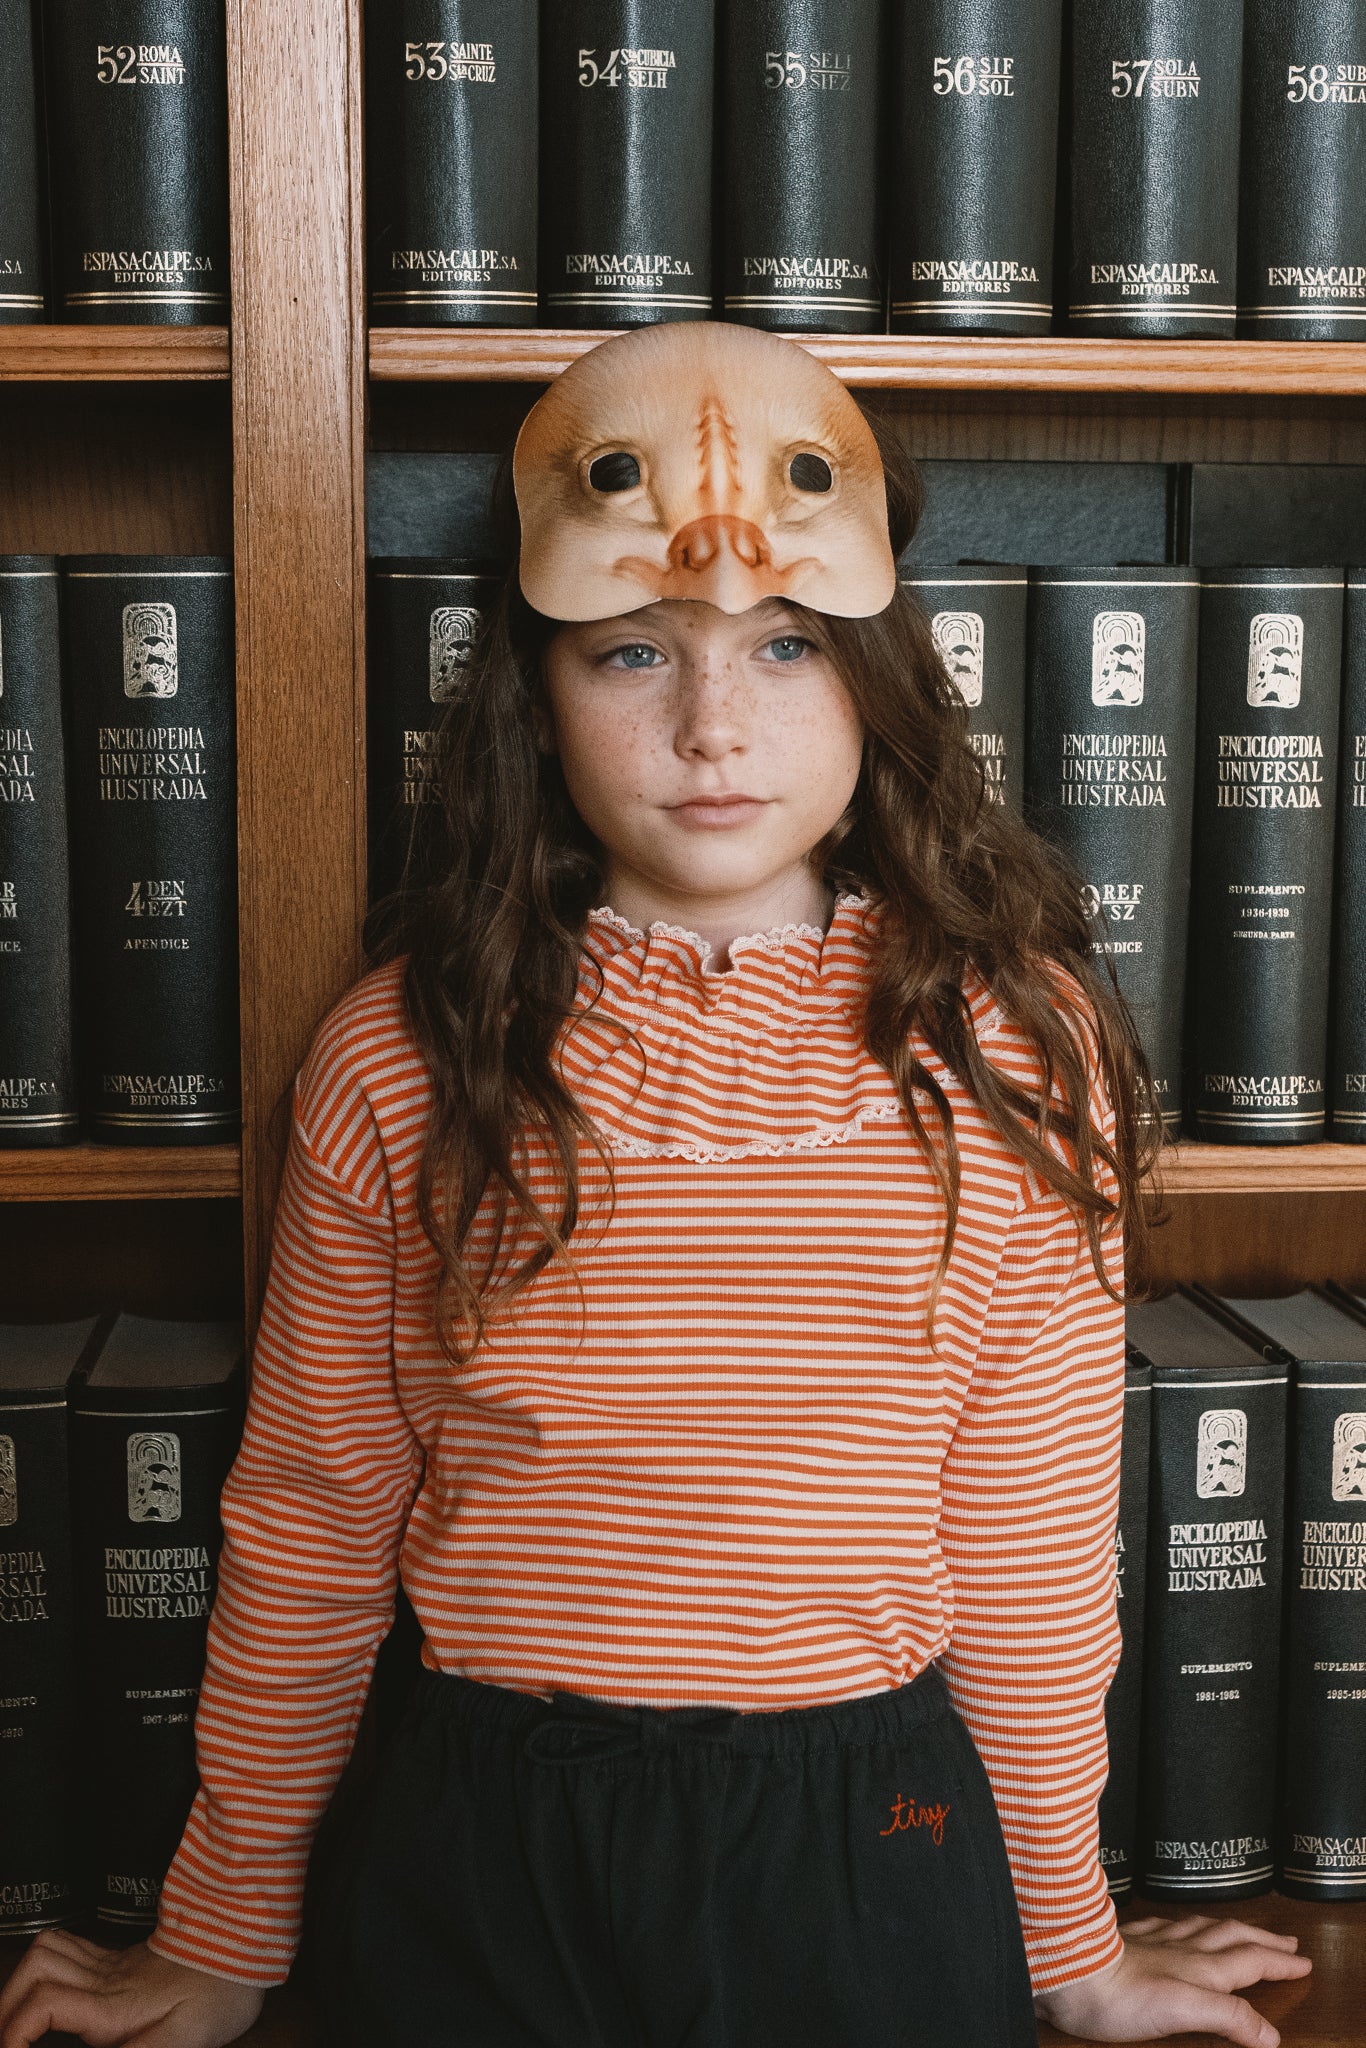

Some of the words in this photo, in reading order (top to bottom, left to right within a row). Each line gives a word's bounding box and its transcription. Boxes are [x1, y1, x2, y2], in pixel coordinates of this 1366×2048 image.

[139, 45, 182, 63] ROMA
[450, 41, 494, 61] SAINTE
[97, 45, 137, 84] 52
[405, 42, 447, 81] 53
[578, 48, 622, 88] 54
[765, 51, 806, 89] 55
[980, 57, 1014, 75] SIF
[1154, 59, 1197, 76] SOLA
[140, 66, 186, 85] SAINT
[628, 70, 667, 89] SELH
[810, 73, 851, 92] SIEZ
[933, 56, 975, 95] 56
[1111, 59, 1153, 98] 57
[1287, 65, 1329, 103] 58
[978, 79, 1014, 96] SOL
[1150, 80, 1199, 98] SUBN
[1329, 85, 1366, 103] TALA
[114, 271, 184, 284] EDITORES
[422, 270, 491, 282] EDITORES
[595, 275, 663, 287] EDITORES
[774, 277, 842, 290] EDITORES
[942, 281, 1011, 293] EDITORES
[1121, 284, 1190, 296] EDITORES
[1299, 286, 1366, 298] EDITORES
[98, 727, 205, 750] ENCICLOPEDIA
[1062, 734, 1167, 757] ENCICLOPEDIA
[1218, 735, 1323, 758] ENCICLOPEDIA
[100, 752, 206, 775] UNIVERSAL
[1063, 759, 1167, 782] UNIVERSAL
[1218, 761, 1323, 783] UNIVERSAL
[100, 778, 207, 801] ILUSTRADA
[1061, 784, 1166, 807] ILUSTRADA
[1217, 785, 1322, 809] ILUSTRADA
[147, 880, 185, 897] DEN
[1103, 884, 1144, 900] REF
[1228, 885, 1306, 895] SUPLEMENTO
[125, 881, 144, 917] 4
[148, 900, 188, 917] EZT
[1110, 904, 1135, 921] SZ
[1240, 907, 1290, 918] 1936-1939
[1233, 930, 1268, 939] SEGUNDA
[1270, 931, 1296, 939] PARTE
[123, 938, 190, 951] APENDICE
[130, 1094, 197, 1107] EDITORES
[1232, 1095, 1299, 1107] EDITORES
[1168, 1519, 1268, 1545] ENCICLOPEDIA
[104, 1547, 211, 1571] ENCICLOPEDIA
[1168, 1542, 1267, 1568] UNIVERSAL
[106, 1569, 211, 1595] UNIVERSAL
[1168, 1566, 1266, 1592] ILUSTRADA
[106, 1595, 211, 1619] ILUSTRADA
[1180, 1661, 1253, 1674] SUPLEMENTO
[1313, 1661, 1366, 1672] SUPLEME
[1195, 1689, 1240, 1702] 1981-1982
[879, 1792, 951, 1847] tiny
[1184, 1856, 1247, 1870] EDITORES
